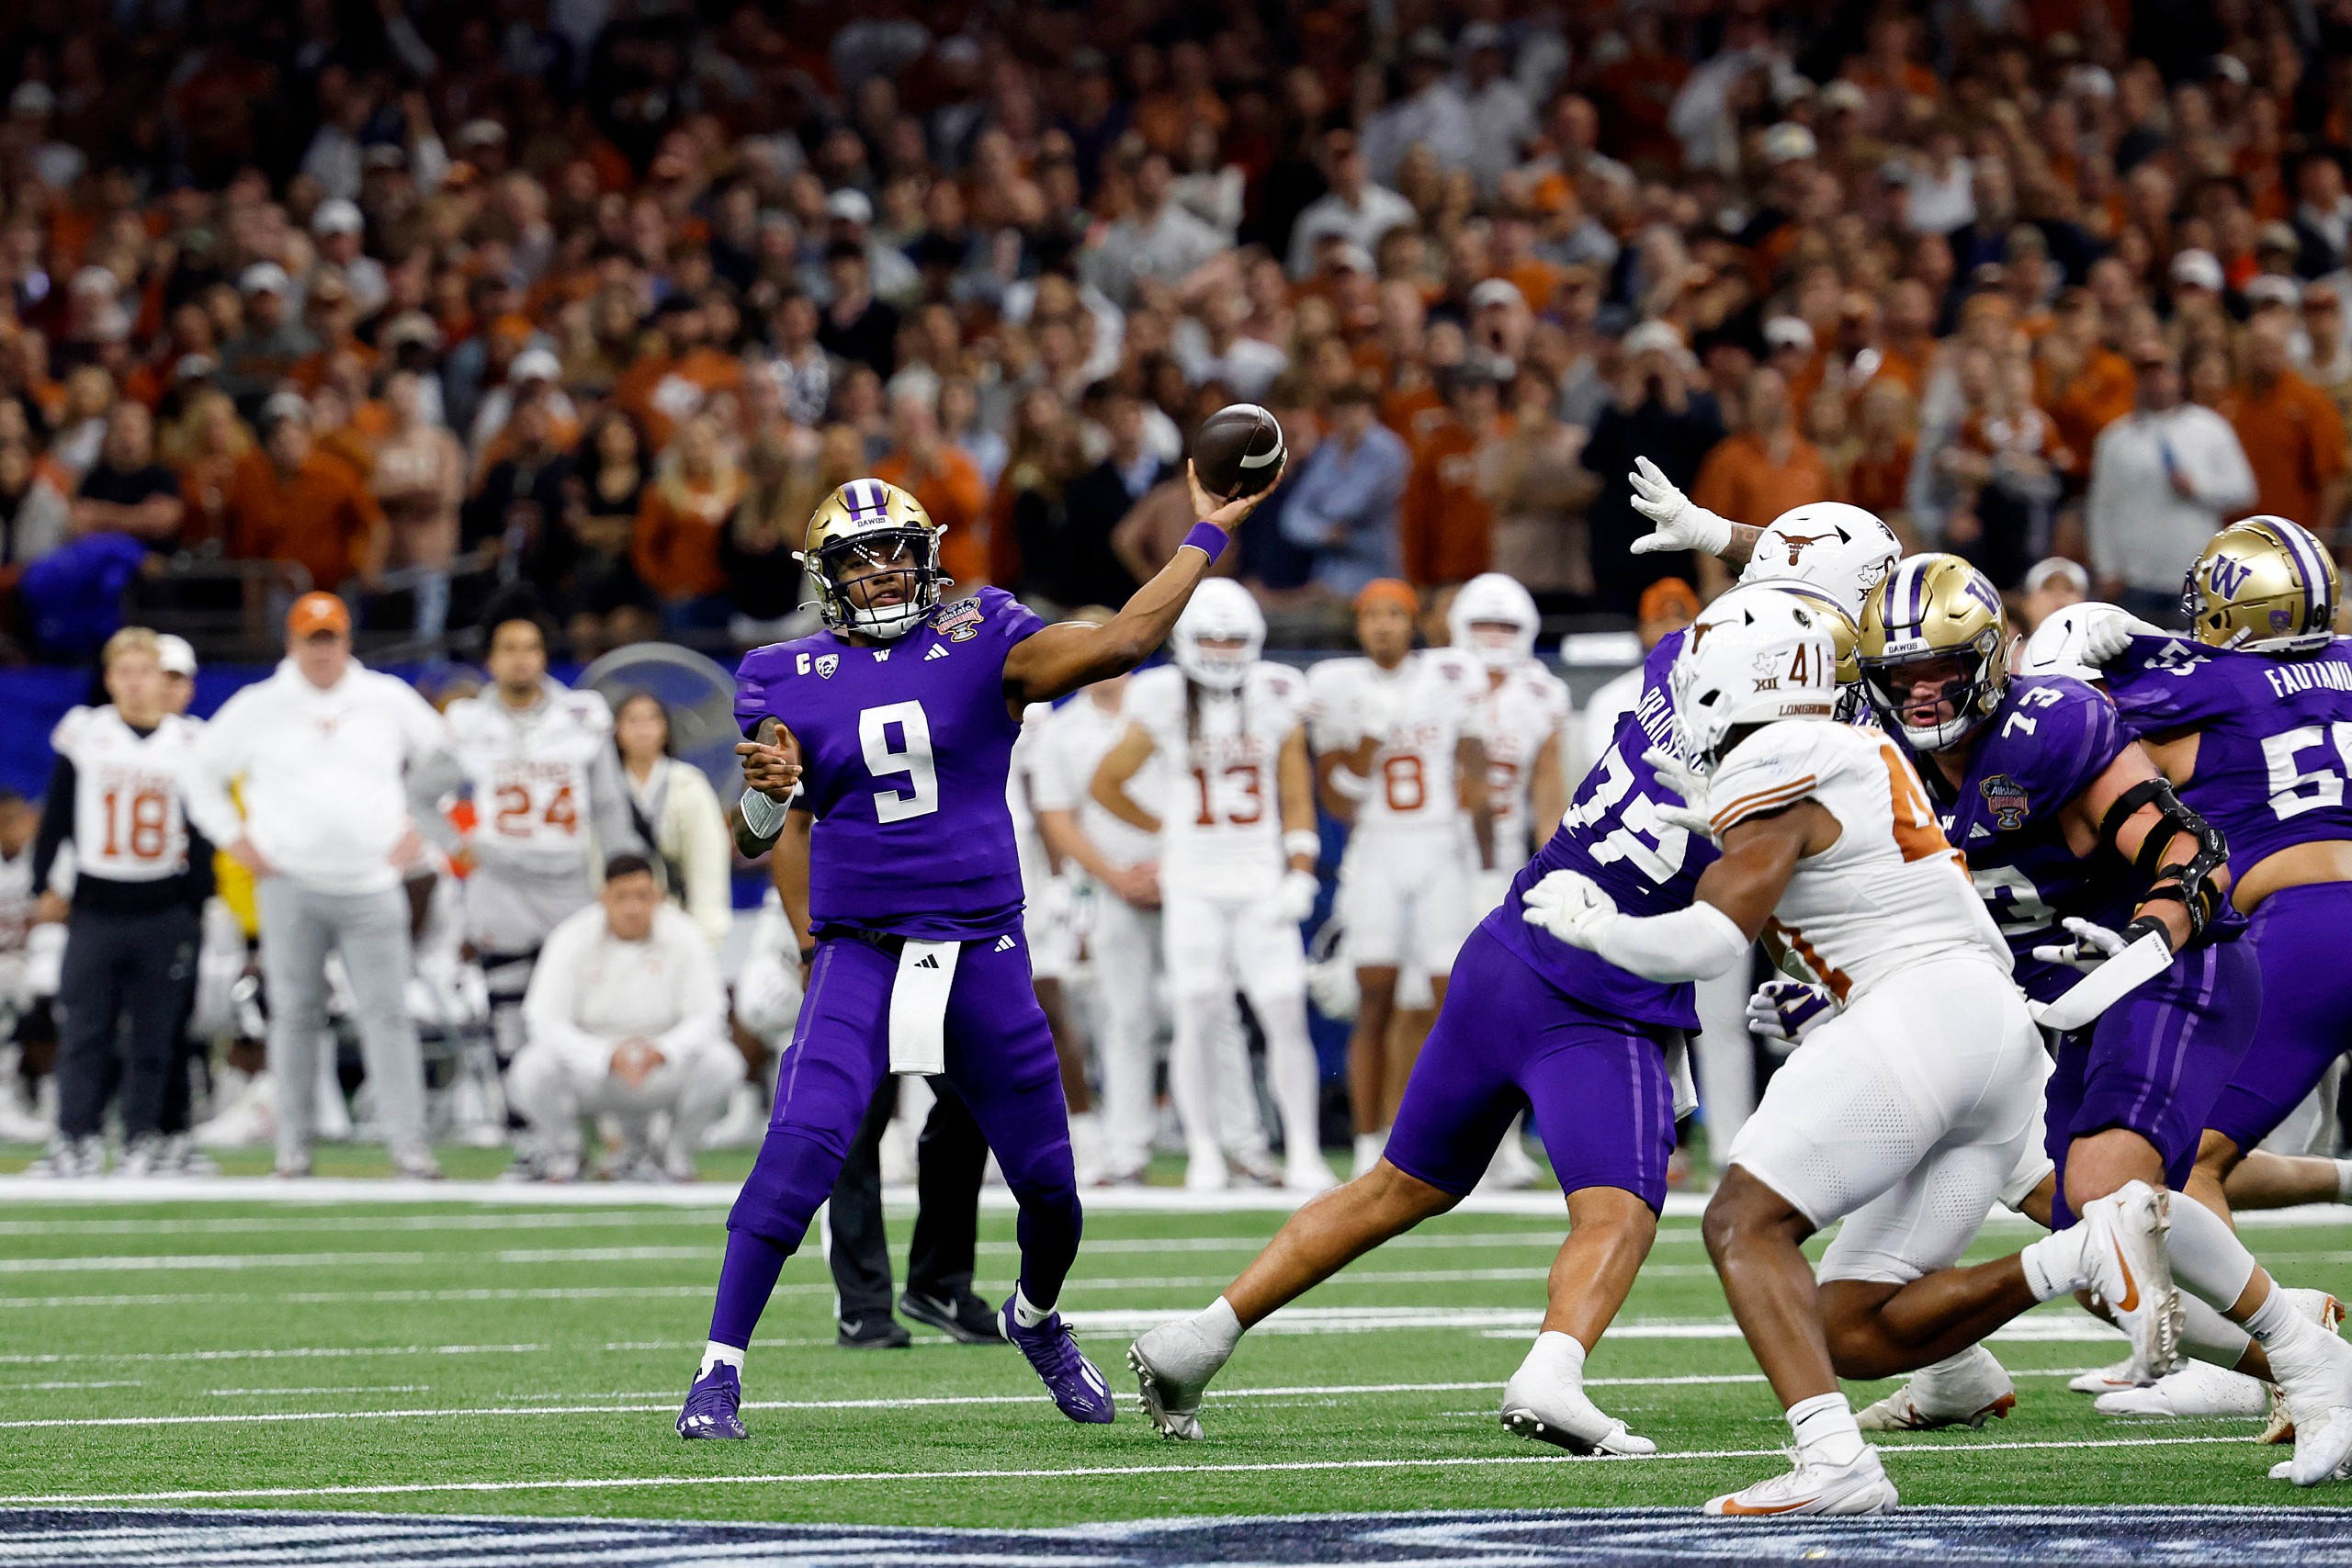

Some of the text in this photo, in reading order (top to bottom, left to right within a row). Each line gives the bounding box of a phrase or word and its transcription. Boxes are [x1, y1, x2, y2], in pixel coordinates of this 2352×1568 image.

[2211, 553, 2253, 603] W
[938, 604, 972, 625] Allstate
[796, 653, 811, 675] C
[820, 664, 833, 675] 12
[872, 649, 891, 662] W
[1789, 642, 1822, 687] 41
[1752, 676, 1781, 693] XII
[2264, 660, 2352, 698] FAUTANU
[2001, 686, 2064, 739] 73
[858, 699, 938, 823] 9
[1384, 755, 1424, 810] 8
[496, 784, 577, 838] 24
[1193, 764, 1262, 825] 13
[103, 792, 168, 859] 18
[1941, 815, 1955, 830] W
